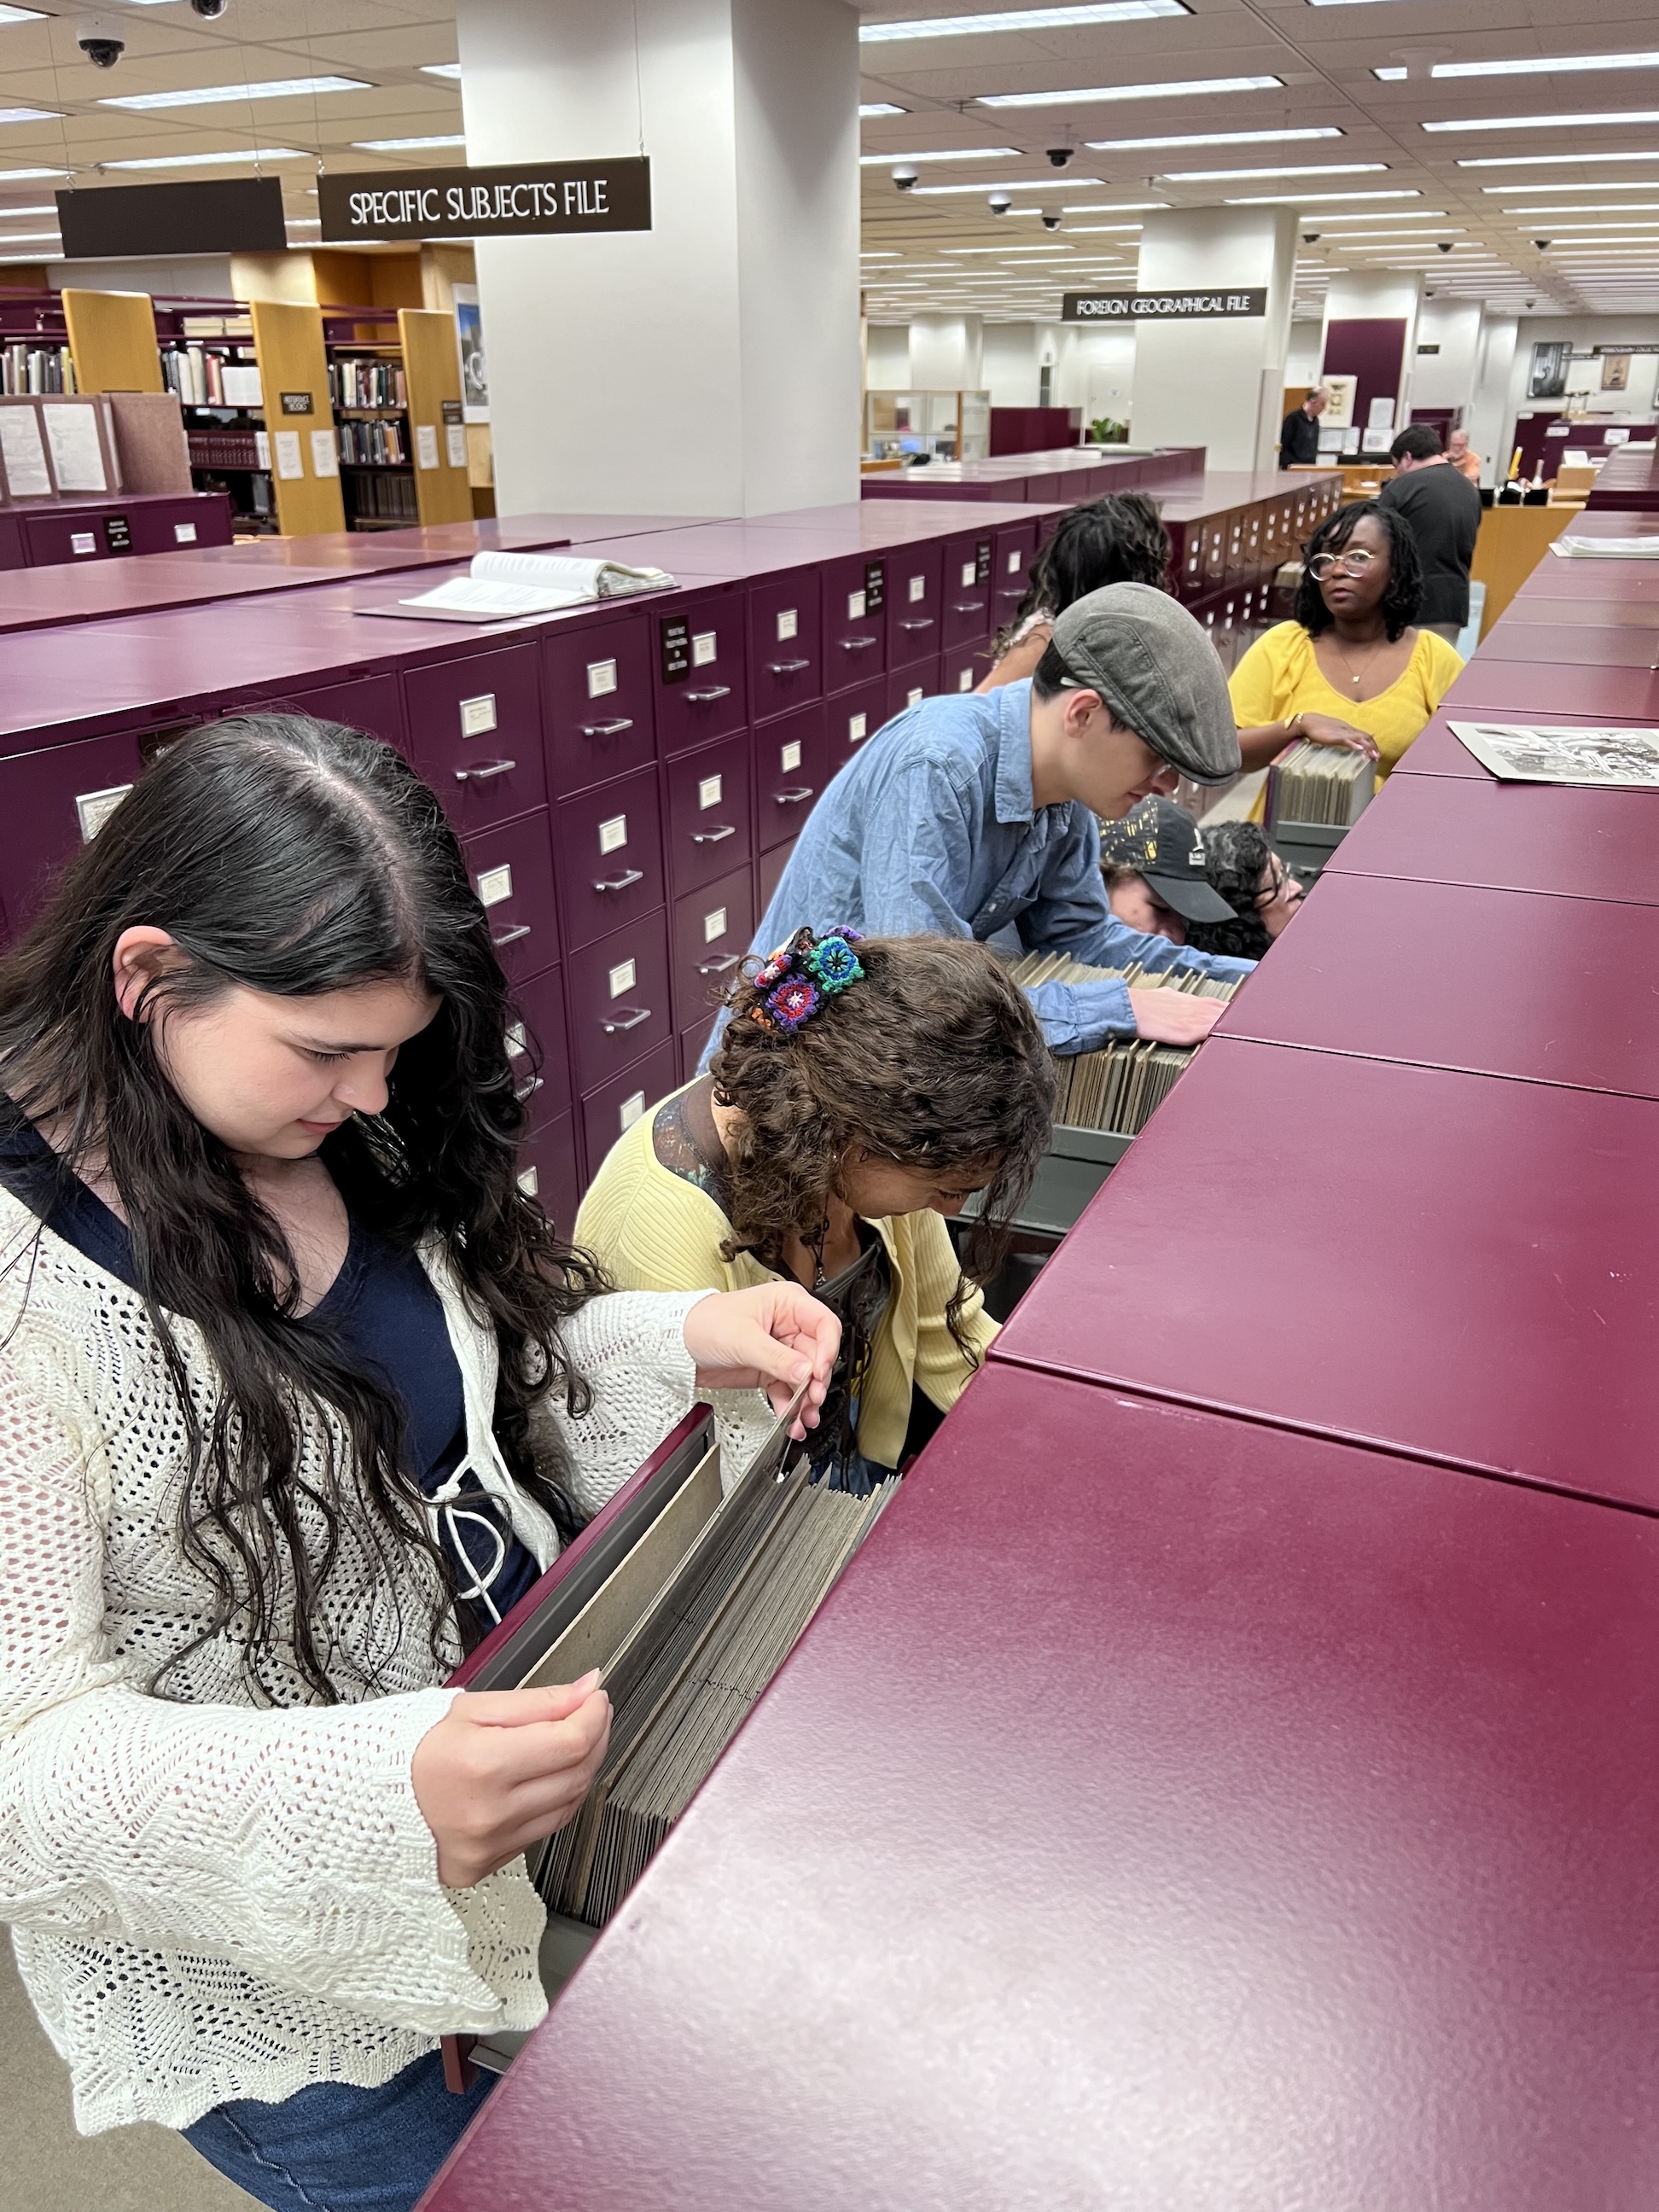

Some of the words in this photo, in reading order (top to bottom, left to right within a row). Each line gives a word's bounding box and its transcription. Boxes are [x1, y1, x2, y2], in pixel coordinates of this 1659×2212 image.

[349, 189, 440, 224] SPECIFIC
[445, 182, 558, 220] SUBJECTS
[562, 179, 609, 215] FILE
[1076, 300, 1128, 315] FOREIGN
[1131, 297, 1224, 313] GEOGRAPHICAL
[1226, 295, 1249, 311] FILE
